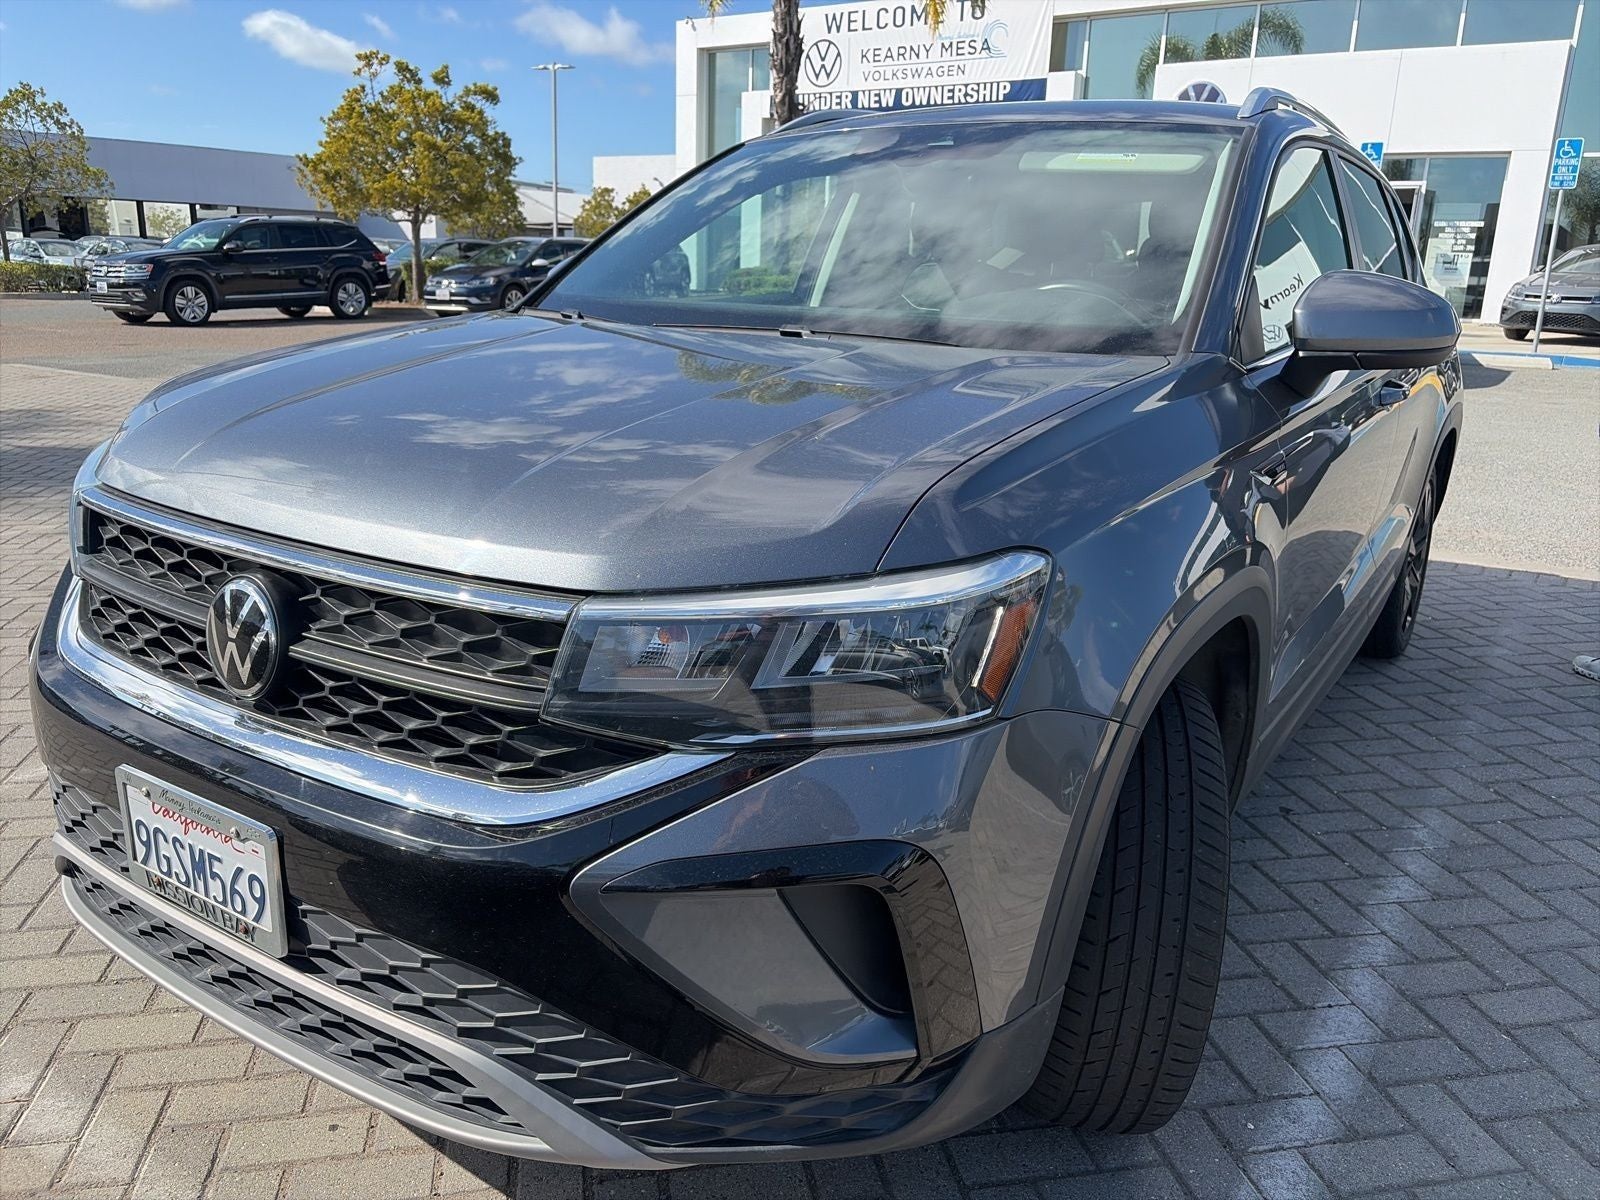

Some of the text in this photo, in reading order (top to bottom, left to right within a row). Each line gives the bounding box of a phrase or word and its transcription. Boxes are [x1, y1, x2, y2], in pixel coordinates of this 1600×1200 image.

[825, 4, 944, 34] WELCOM
[861, 38, 992, 64] KEARNY MESA
[863, 64, 967, 82] VOLKSWAGEN
[798, 81, 1011, 111] UNDER NEW OWNERSHIP
[1557, 166, 1573, 174] ONLY
[135, 818, 266, 925] 9GSM569
